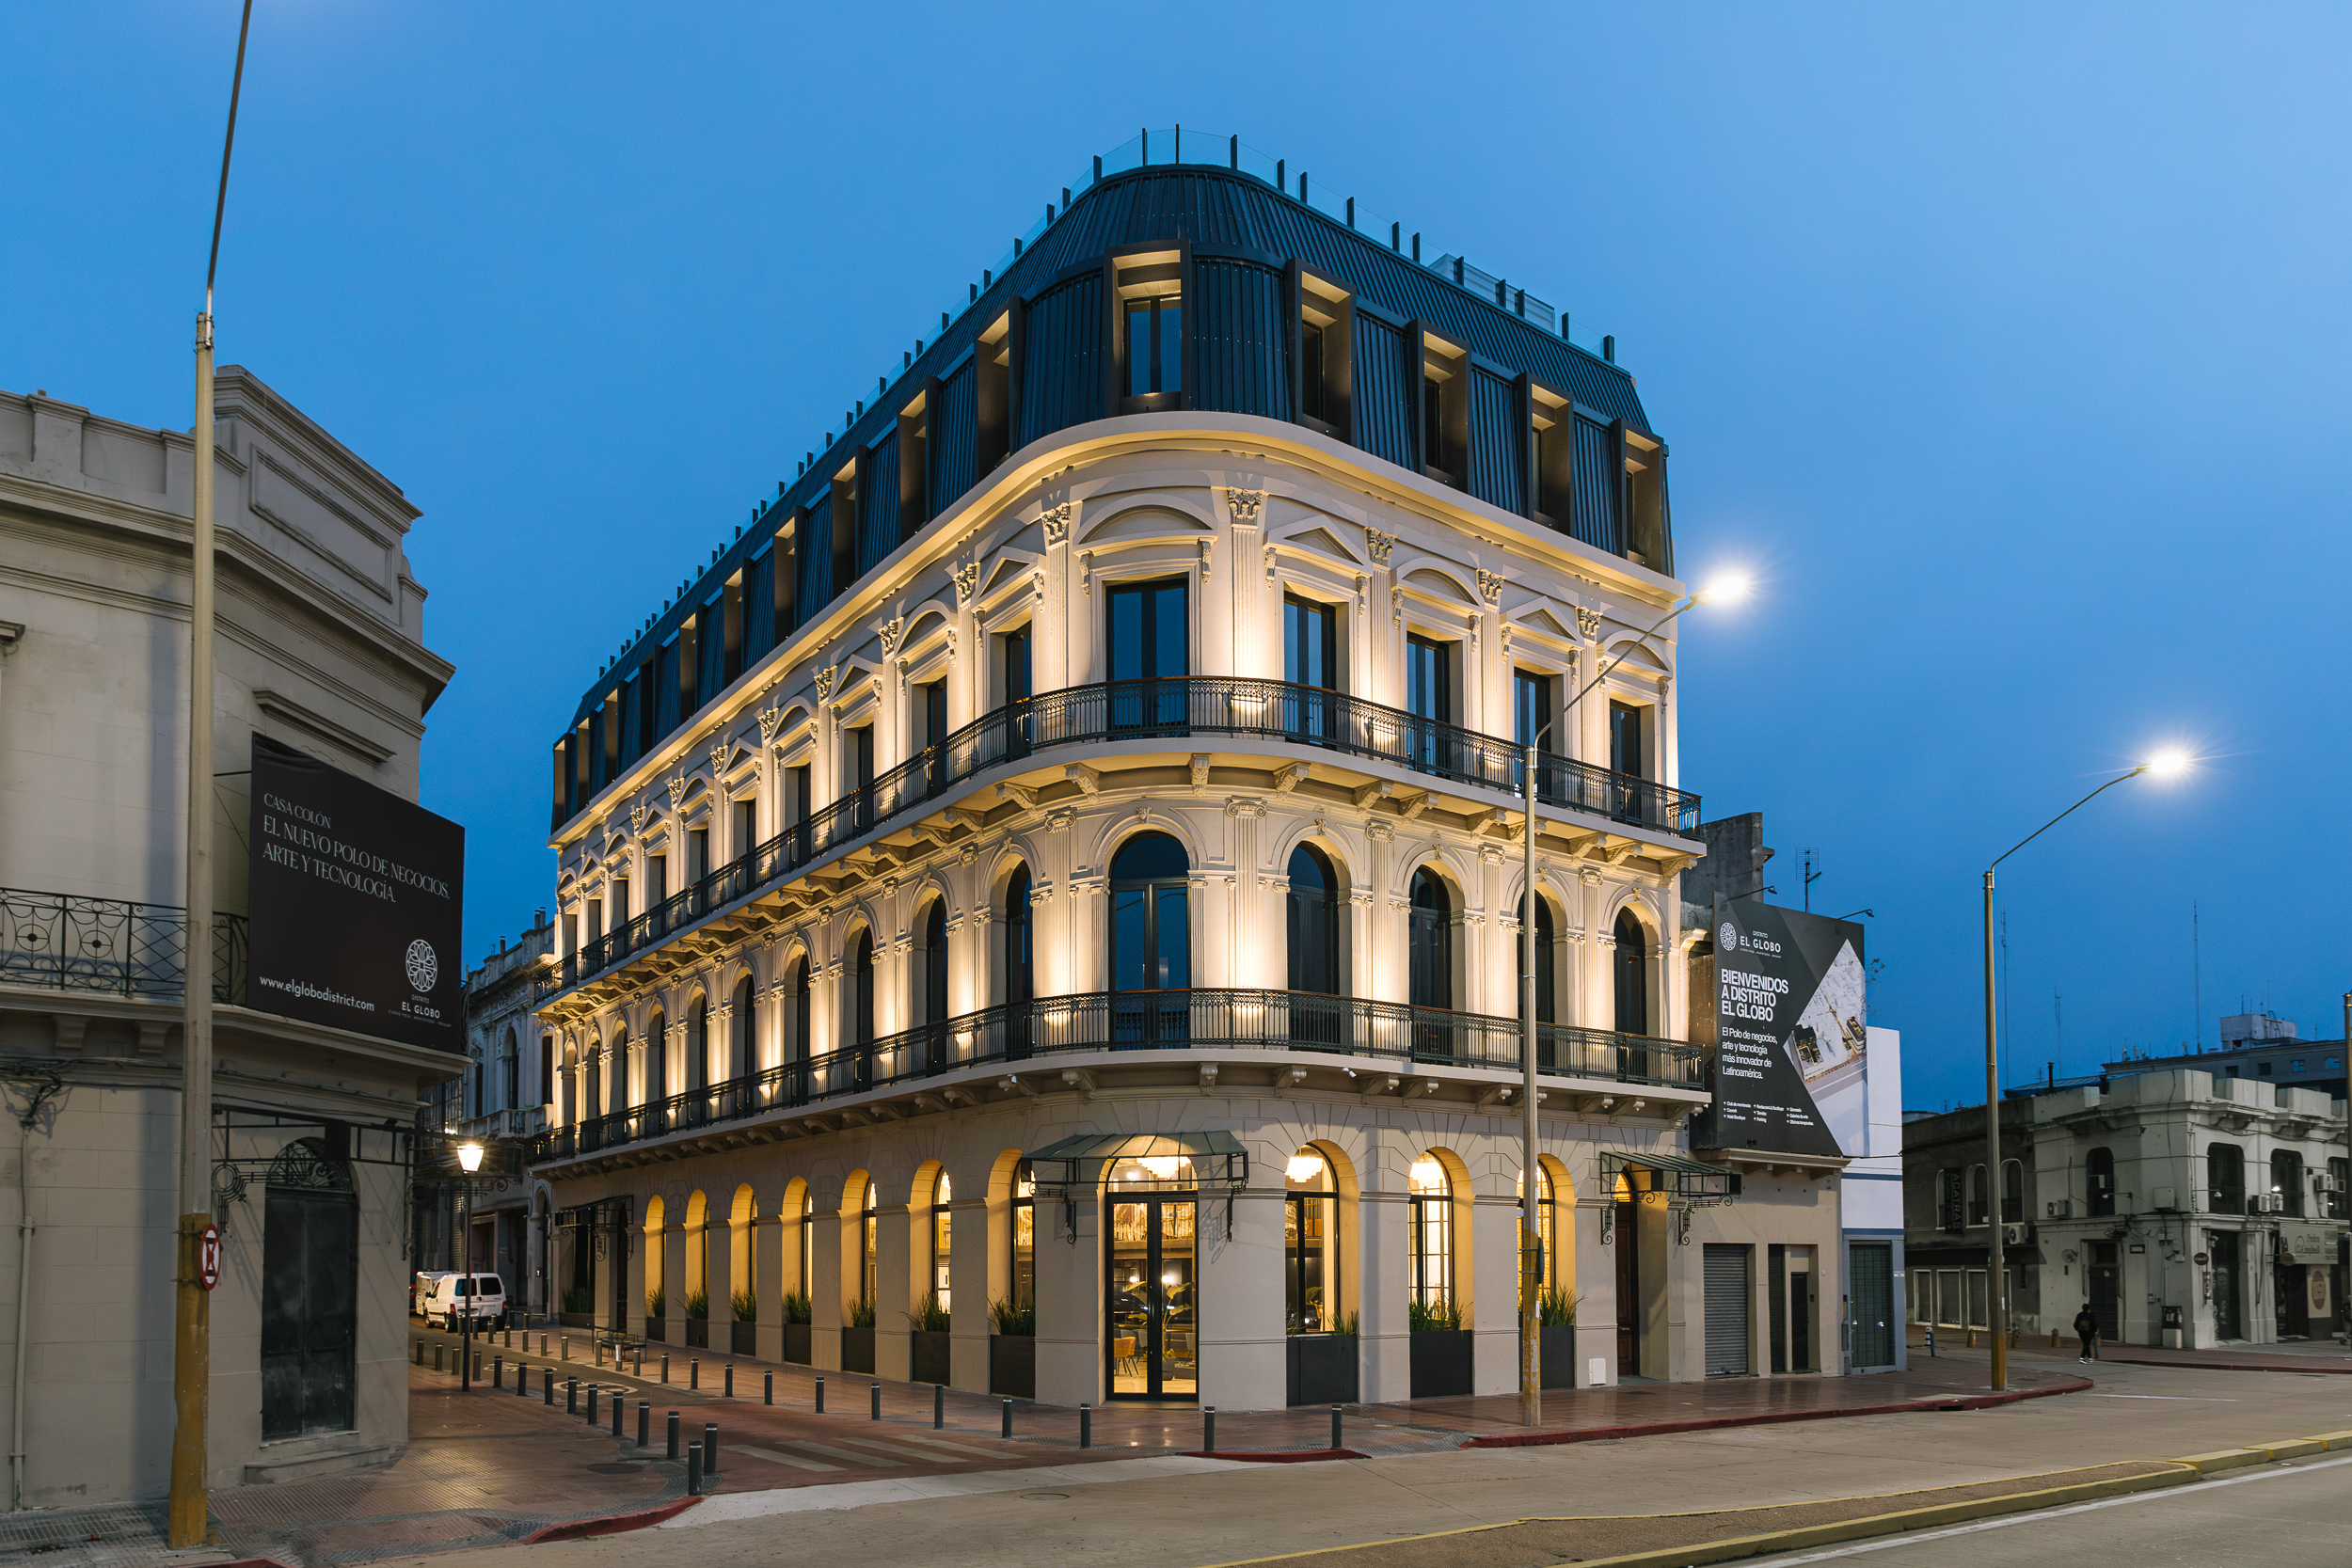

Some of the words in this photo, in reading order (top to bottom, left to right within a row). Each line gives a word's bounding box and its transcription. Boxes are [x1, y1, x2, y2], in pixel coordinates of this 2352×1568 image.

[263, 793, 293, 816] CASA
[294, 805, 331, 830] COLÓN
[263, 814, 280, 837] EL
[283, 822, 331, 854] NUEVO
[334, 841, 371, 869] POLO
[373, 855, 389, 877] DE
[262, 842, 299, 870] ARTE
[301, 854, 311, 873] Y
[1740, 936, 1750, 946] EL
[1753, 939, 1781, 952] GLOBO
[1753, 930, 1768, 939] DISTRITO
[1721, 968, 1788, 994] BIENVENIDOS
[260, 976, 374, 1012] www.elglobodistrict.com
[412, 994, 430, 1004] DISTRITO
[1721, 985, 1729, 999] A
[1731, 986, 1776, 1007] DISTRITO
[402, 1001, 411, 1012] EL
[414, 1005, 440, 1019] GLOBO
[1722, 1000, 1735, 1016] EL
[1737, 1003, 1773, 1022] GLOBO
[1722, 1027, 1728, 1037] El
[1729, 1027, 1742, 1038] Polo
[1743, 1030, 1751, 1039] de
[1752, 1033, 1777, 1044] negocios,
[1722, 1041, 1734, 1050] arte
[1734, 1043, 1739, 1053] y
[1740, 1043, 1768, 1055] tecnología
[1722, 1053, 1735, 1063] más
[1736, 1054, 1763, 1066] innovador
[1764, 1058, 1772, 1068] de
[1723, 1066, 1763, 1079] Latinoamérica.
[1953, 1173, 1962, 1229] ACATRAS
